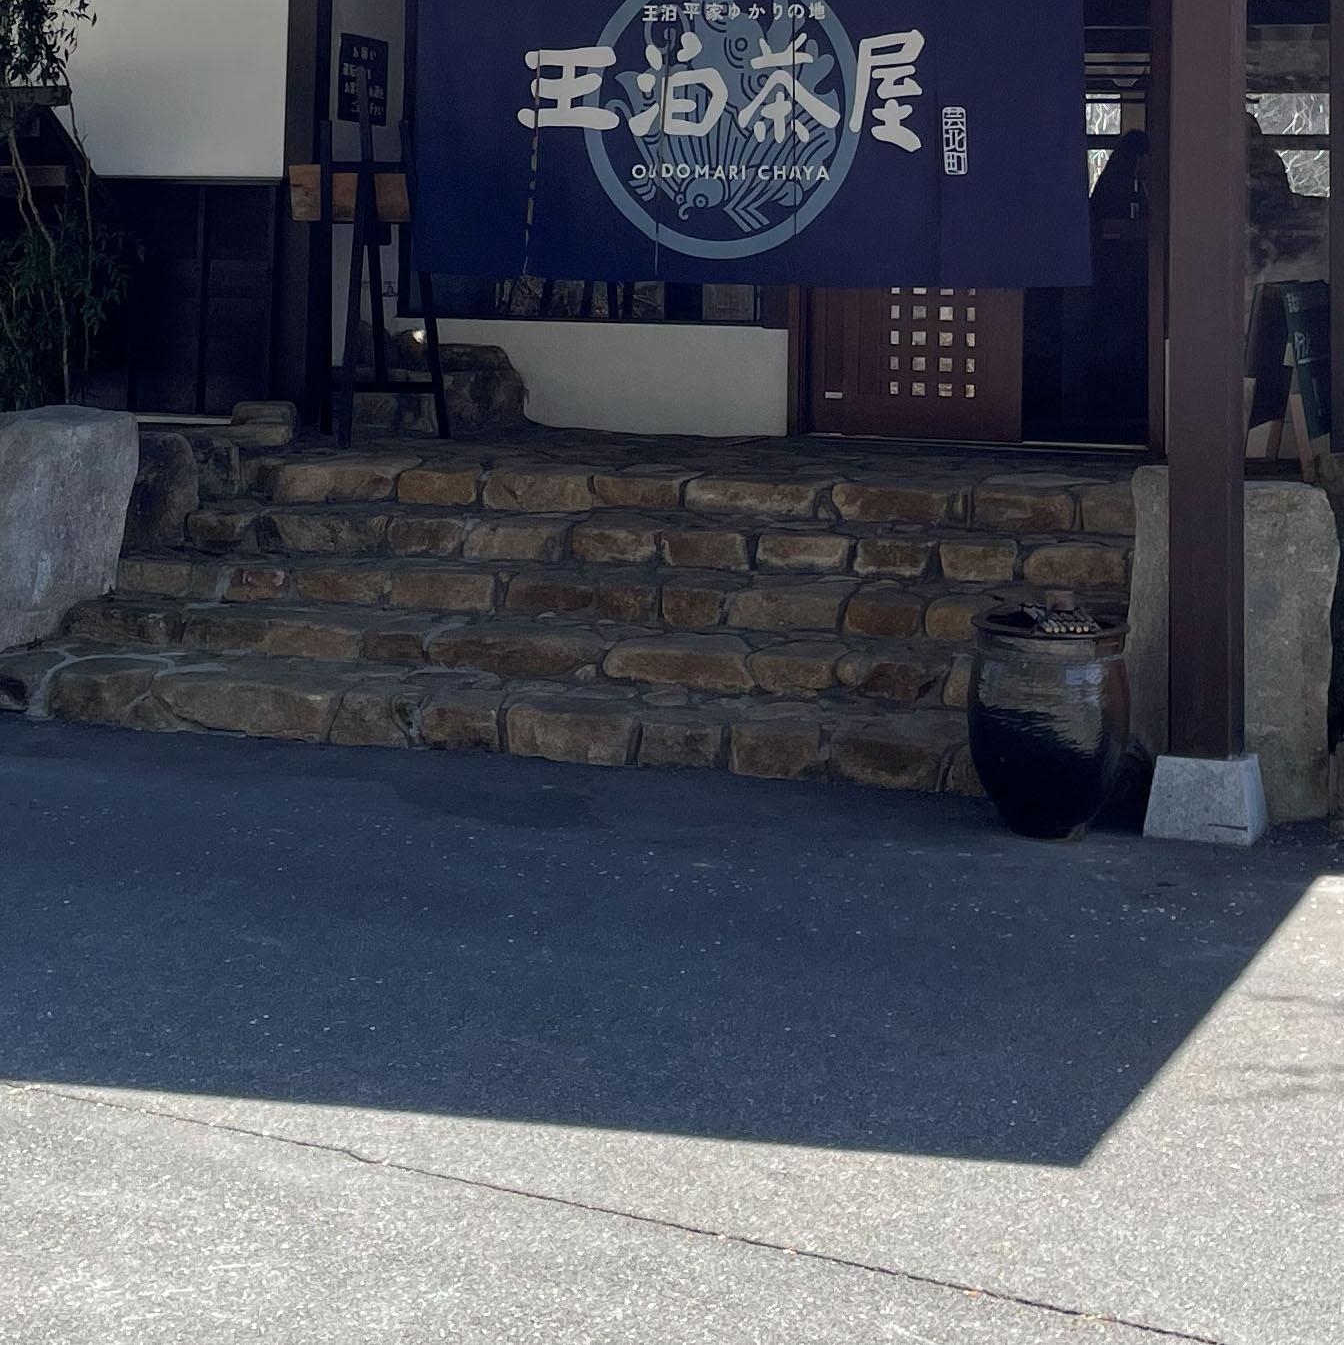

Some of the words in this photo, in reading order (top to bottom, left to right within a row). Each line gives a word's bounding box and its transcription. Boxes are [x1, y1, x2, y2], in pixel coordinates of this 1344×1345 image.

[641, 2, 826, 22] 王泊平家ゆかりの地
[517, 29, 925, 152] 王泊茶屋
[757, 165, 830, 180] CHAYA
